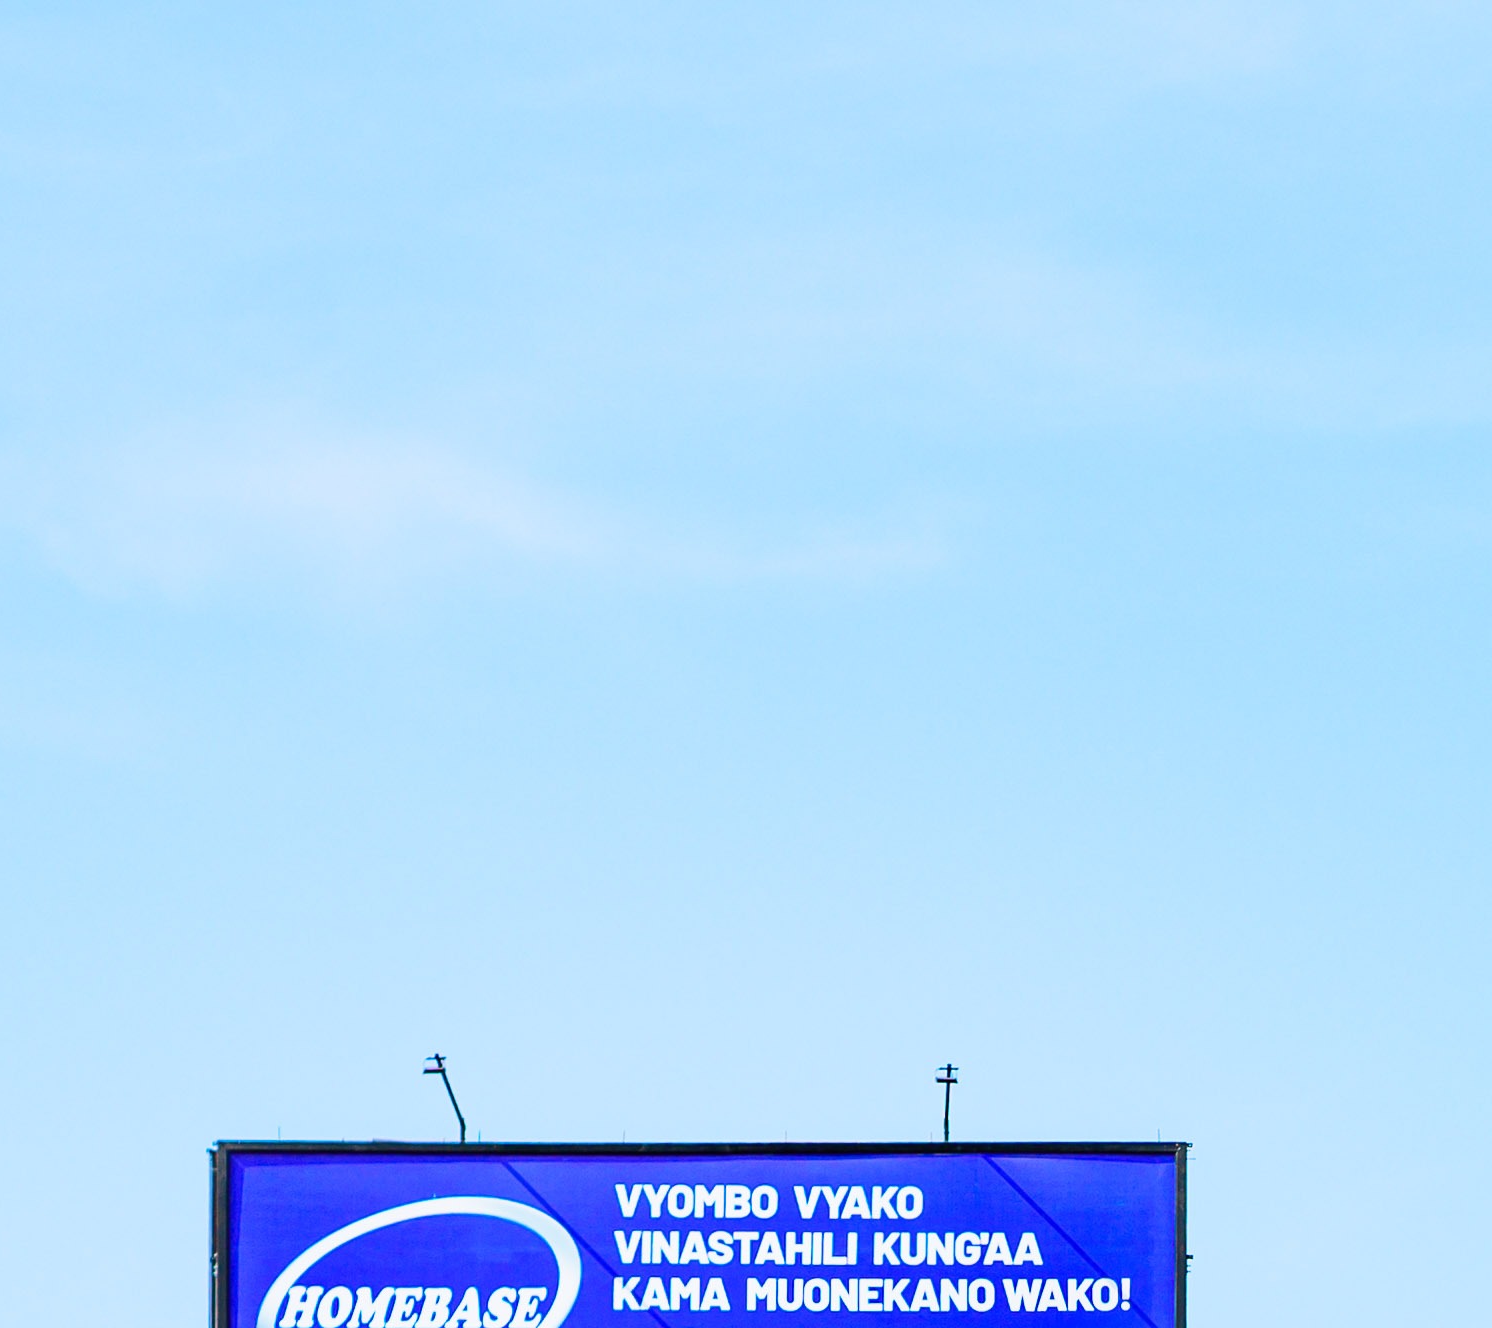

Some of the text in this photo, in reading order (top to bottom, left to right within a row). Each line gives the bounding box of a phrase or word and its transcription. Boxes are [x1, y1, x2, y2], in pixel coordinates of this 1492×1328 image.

[615, 1183, 924, 1220] VYOMBO VYAKO
[614, 1230, 1044, 1266] VINASTAHILI KUNG'AA
[612, 1276, 1132, 1313] KAMA MUONEKANO WAKO!
